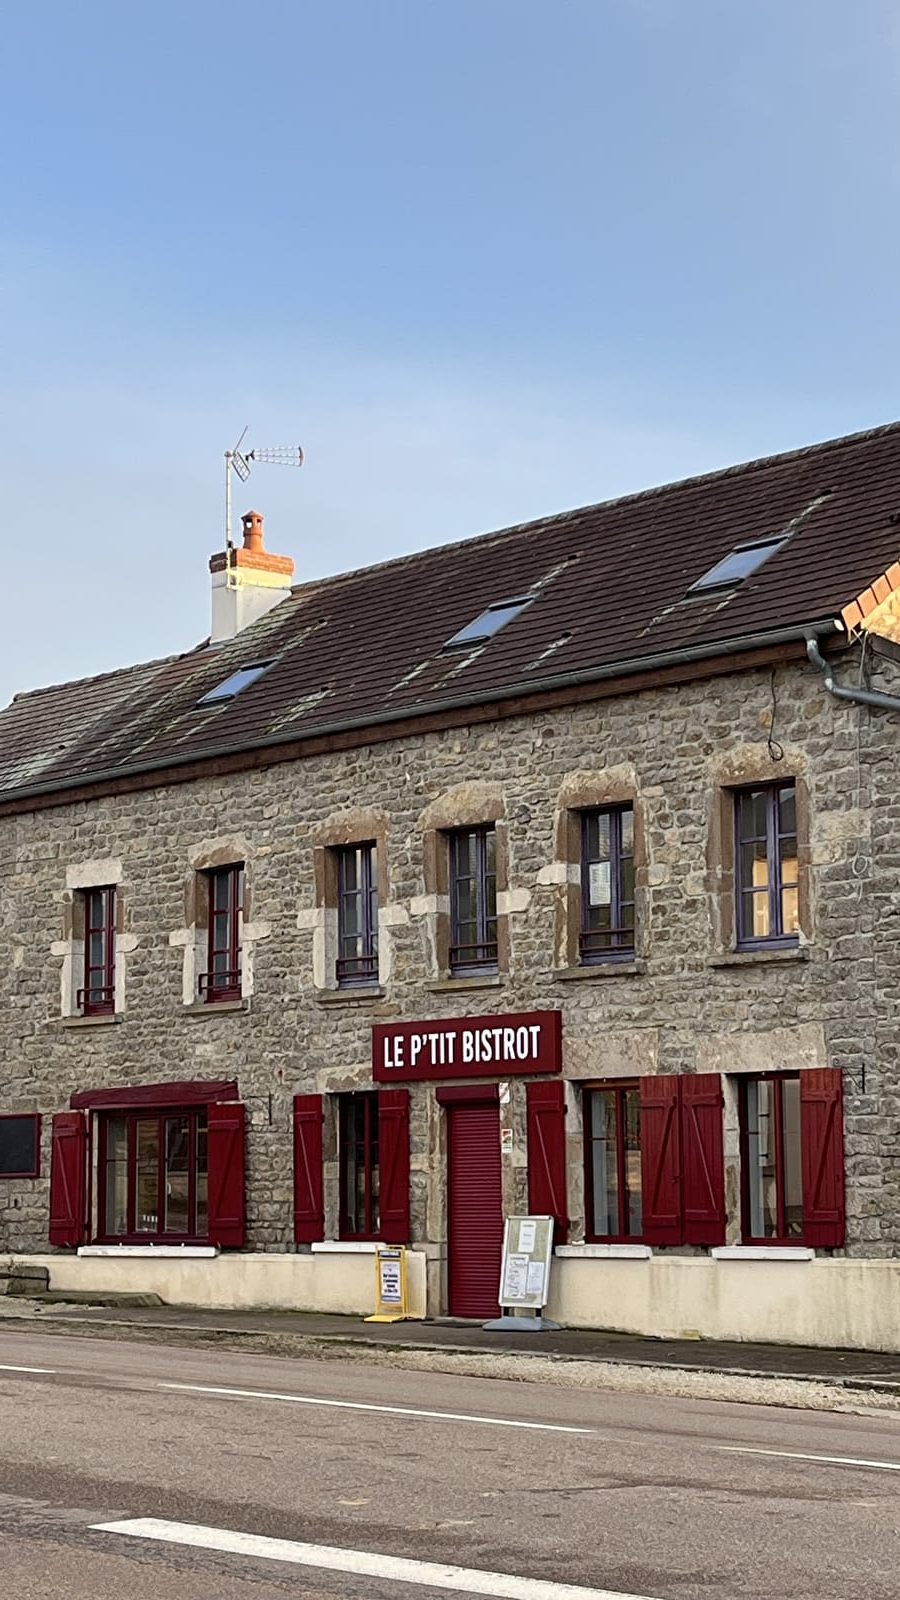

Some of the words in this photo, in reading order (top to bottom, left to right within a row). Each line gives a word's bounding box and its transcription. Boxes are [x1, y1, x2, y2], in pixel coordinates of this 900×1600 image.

[384, 1036, 404, 1068] LE
[410, 1032, 457, 1066] P'TIT
[462, 1025, 541, 1062] BISTROT
